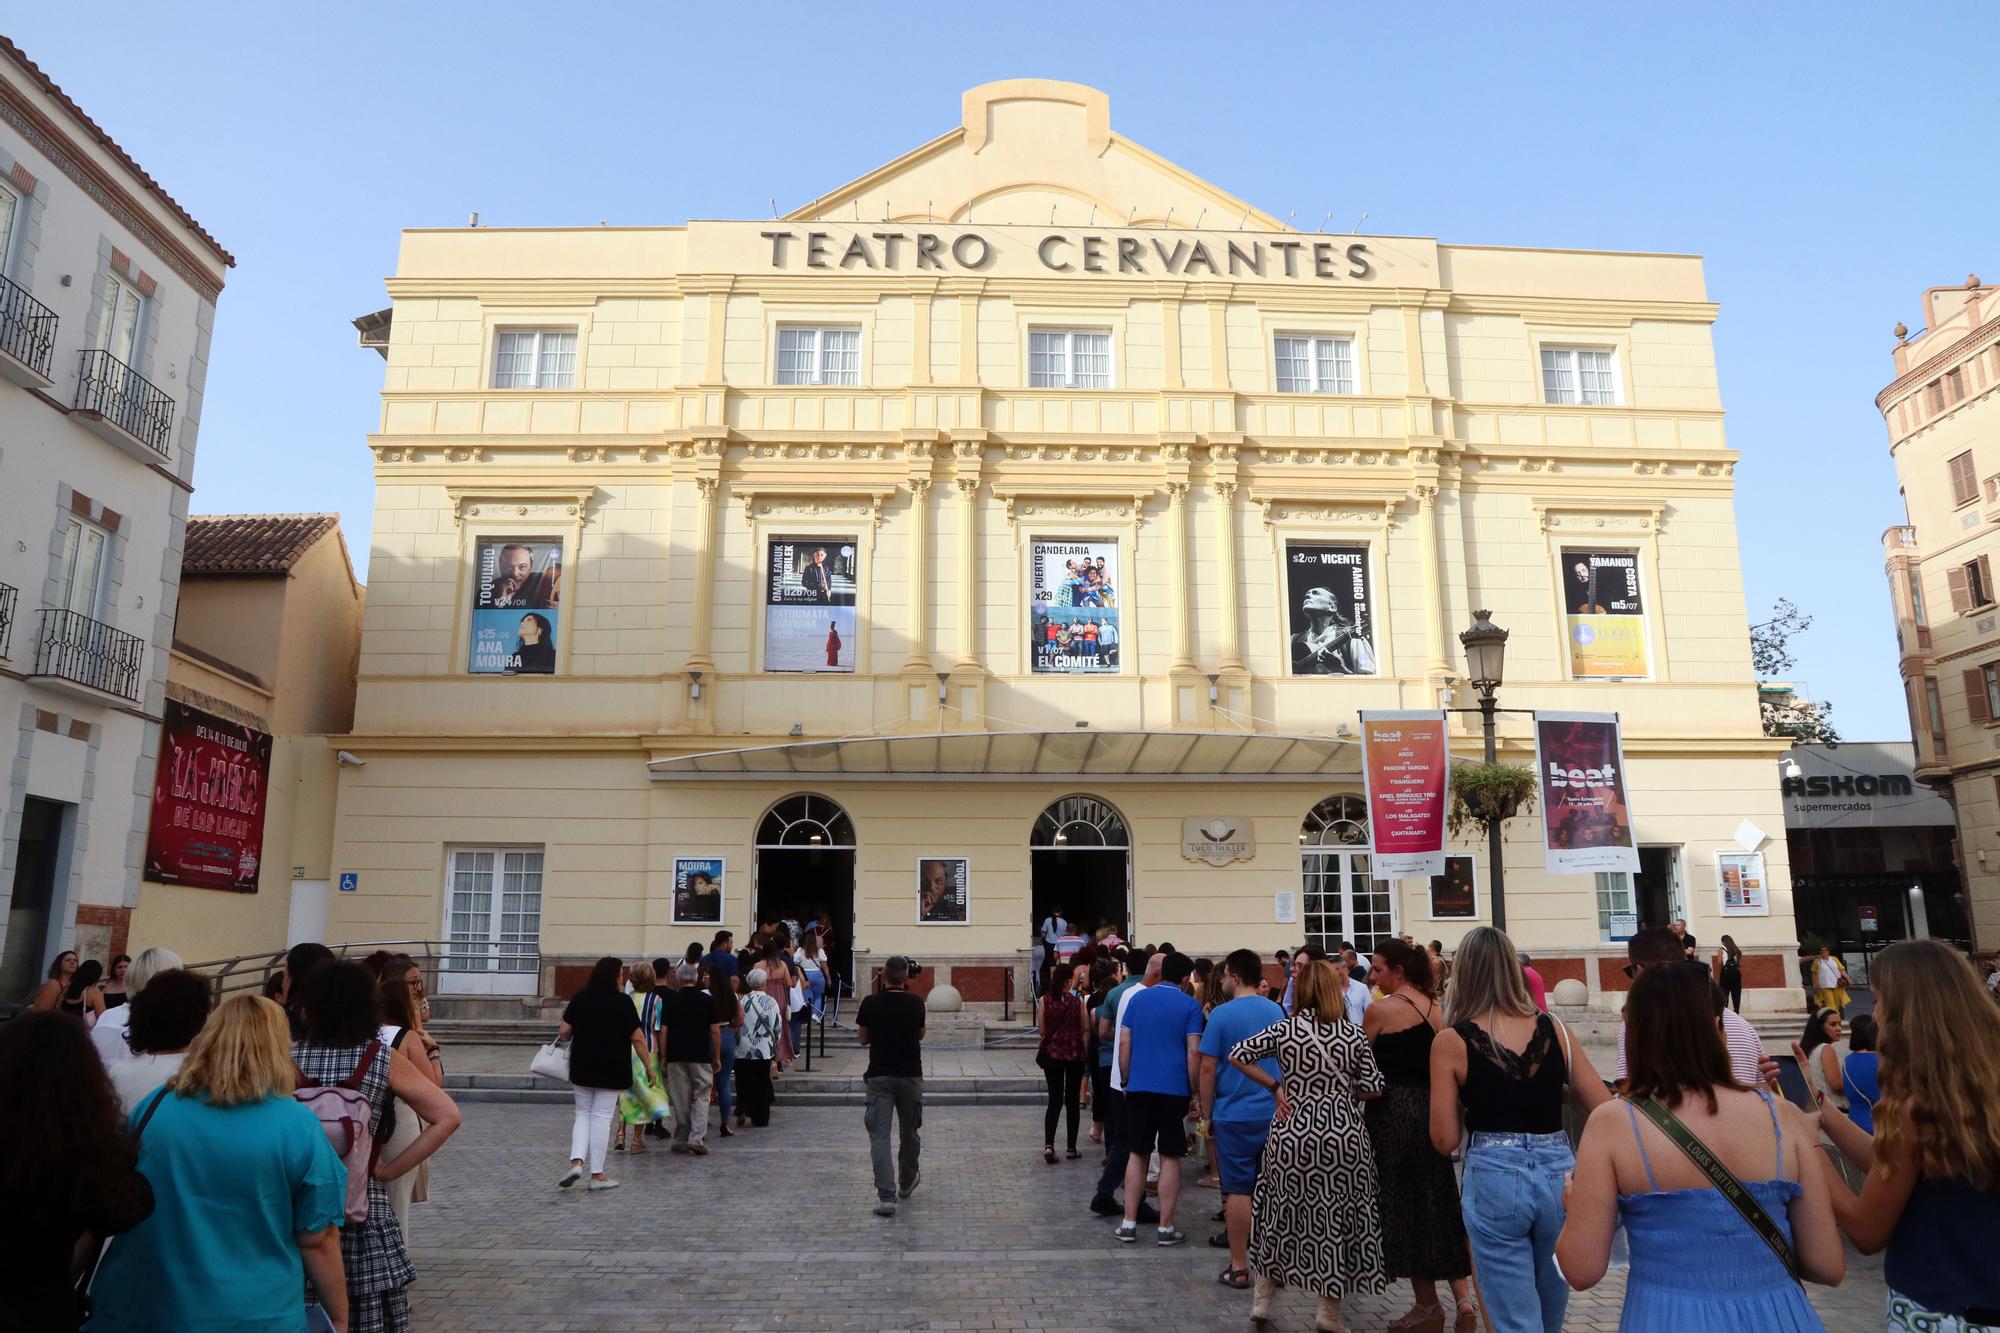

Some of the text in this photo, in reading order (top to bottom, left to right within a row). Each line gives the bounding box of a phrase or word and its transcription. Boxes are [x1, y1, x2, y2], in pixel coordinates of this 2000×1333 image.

[760, 231, 1371, 280] TEATRO CERVANTES
[783, 545, 794, 584] TEKBILEK
[1035, 546, 1089, 555] CANDELARIA
[1321, 554, 1362, 565] VICENTE
[1590, 557, 1633, 568] YAMANDU
[480, 548, 494, 606] TOQUINHO
[773, 545, 783, 601] OMAR FARUK
[1035, 555, 1043, 588] PUERTO
[1352, 566, 1364, 600] AMIGO
[1625, 568, 1637, 597] COSTA
[1035, 591, 1052, 601] x29
[1354, 603, 1362, 634] concierto
[476, 655, 522, 667] MOURA
[477, 641, 503, 653] ANA
[1038, 654, 1100, 667] EL COMITÉ
[196, 725, 207, 739] DEL
[227, 735, 234, 748] DE
[234, 738, 248, 752] JULIO
[171, 746, 258, 815] LA JAULA
[1549, 762, 1616, 788] beat
[1794, 802, 1872, 812] supermercados
[174, 805, 248, 839] DE LAS LOCAS
[678, 870, 687, 889] ANA
[679, 862, 711, 870] MOURA
[954, 862, 965, 905] TOQUINHO
[1687, 1141, 1742, 1198] LOUIS VUITTON
